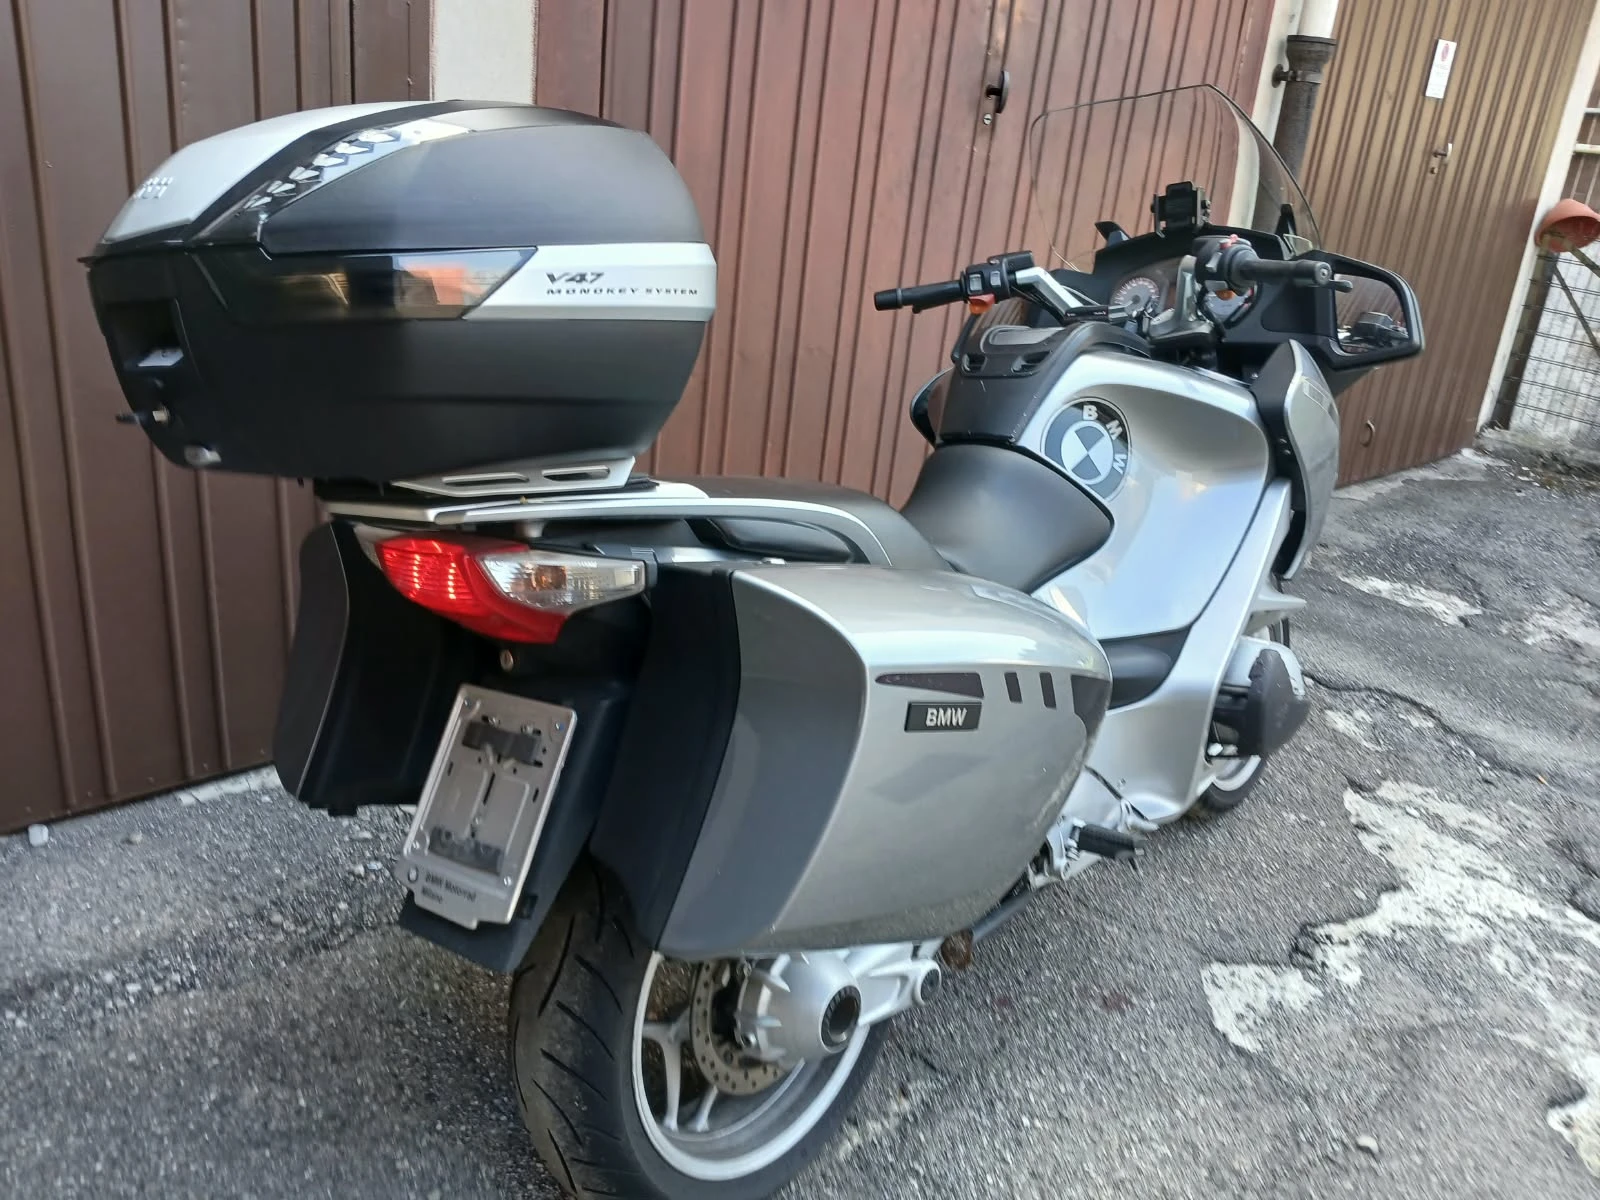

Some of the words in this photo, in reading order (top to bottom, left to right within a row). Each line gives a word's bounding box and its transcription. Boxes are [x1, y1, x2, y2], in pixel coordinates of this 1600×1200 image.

[546, 272, 604, 284] V47
[546, 287, 639, 295] MONOKEY
[1082, 404, 1127, 475] BMW
[925, 707, 967, 727] BMW
